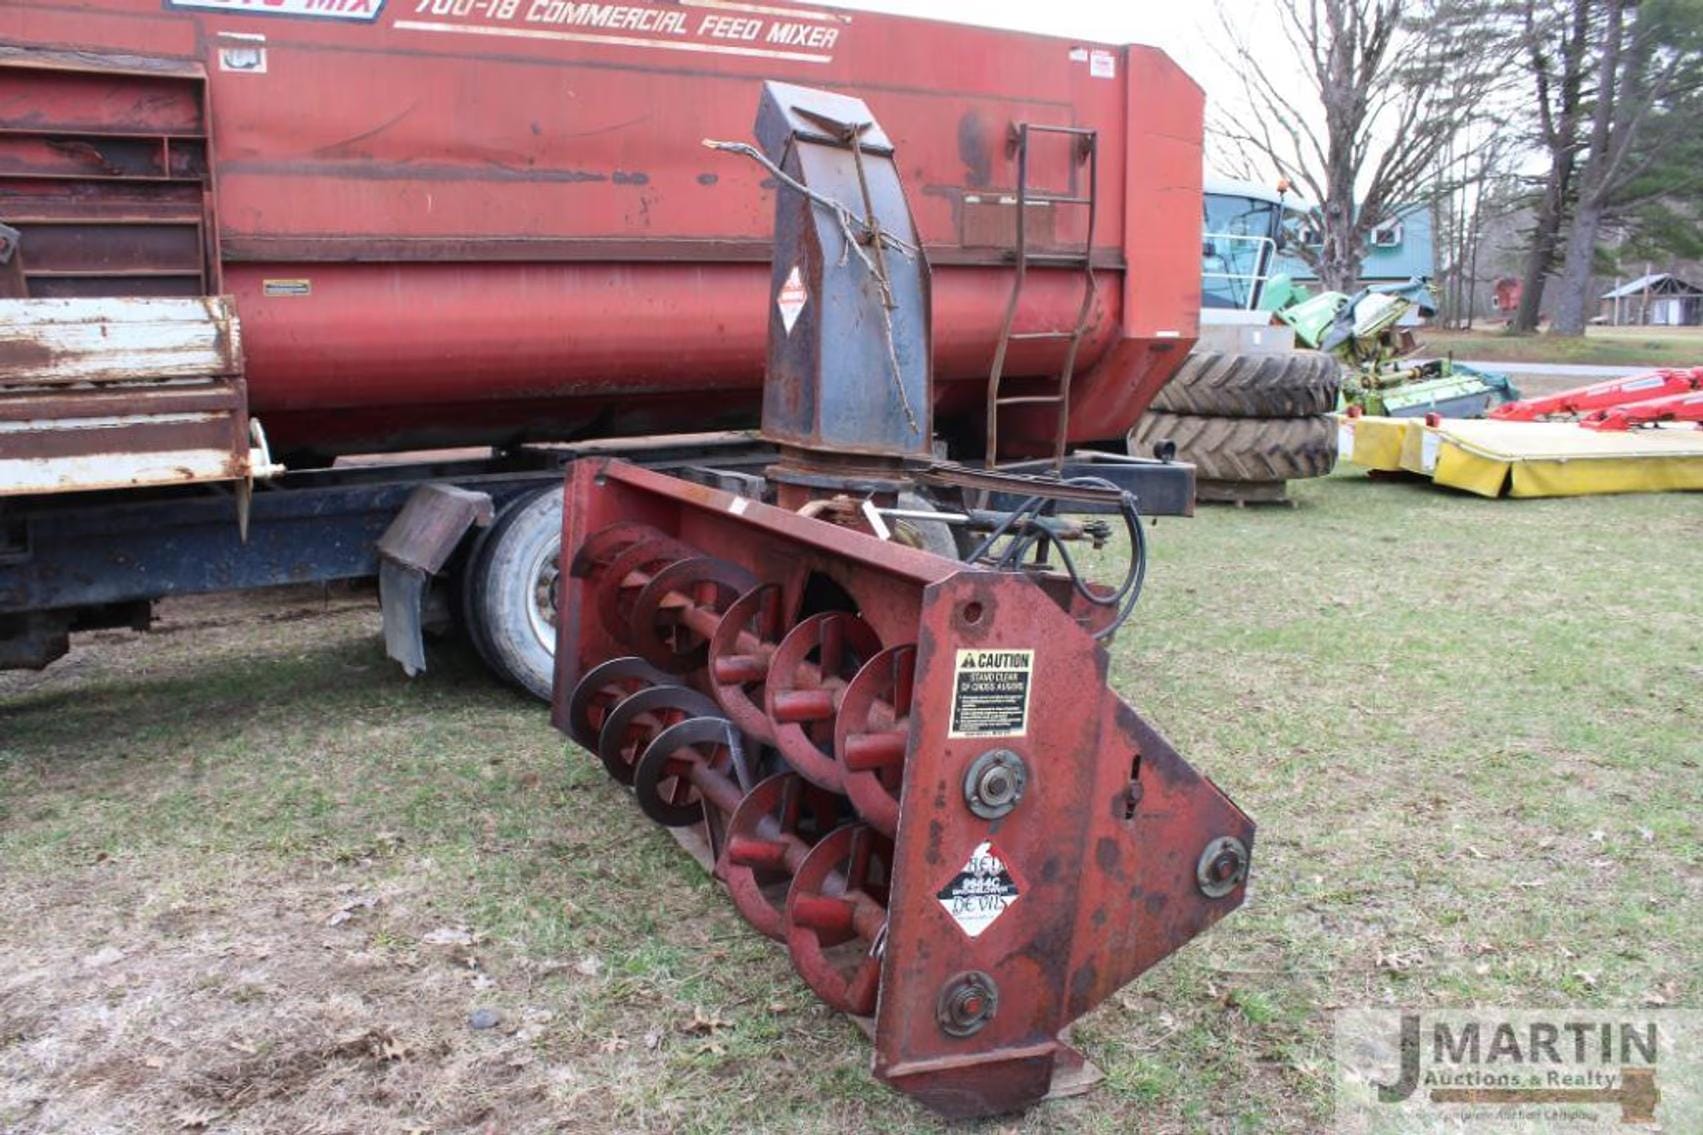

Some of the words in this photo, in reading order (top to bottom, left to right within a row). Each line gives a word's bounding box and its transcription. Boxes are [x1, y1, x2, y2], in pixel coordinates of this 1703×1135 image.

[525, 0, 687, 34] COMMERCIAL
[697, 15, 762, 40] FEED
[766, 21, 839, 49] MIXER
[978, 653, 1030, 668] CAUTION
